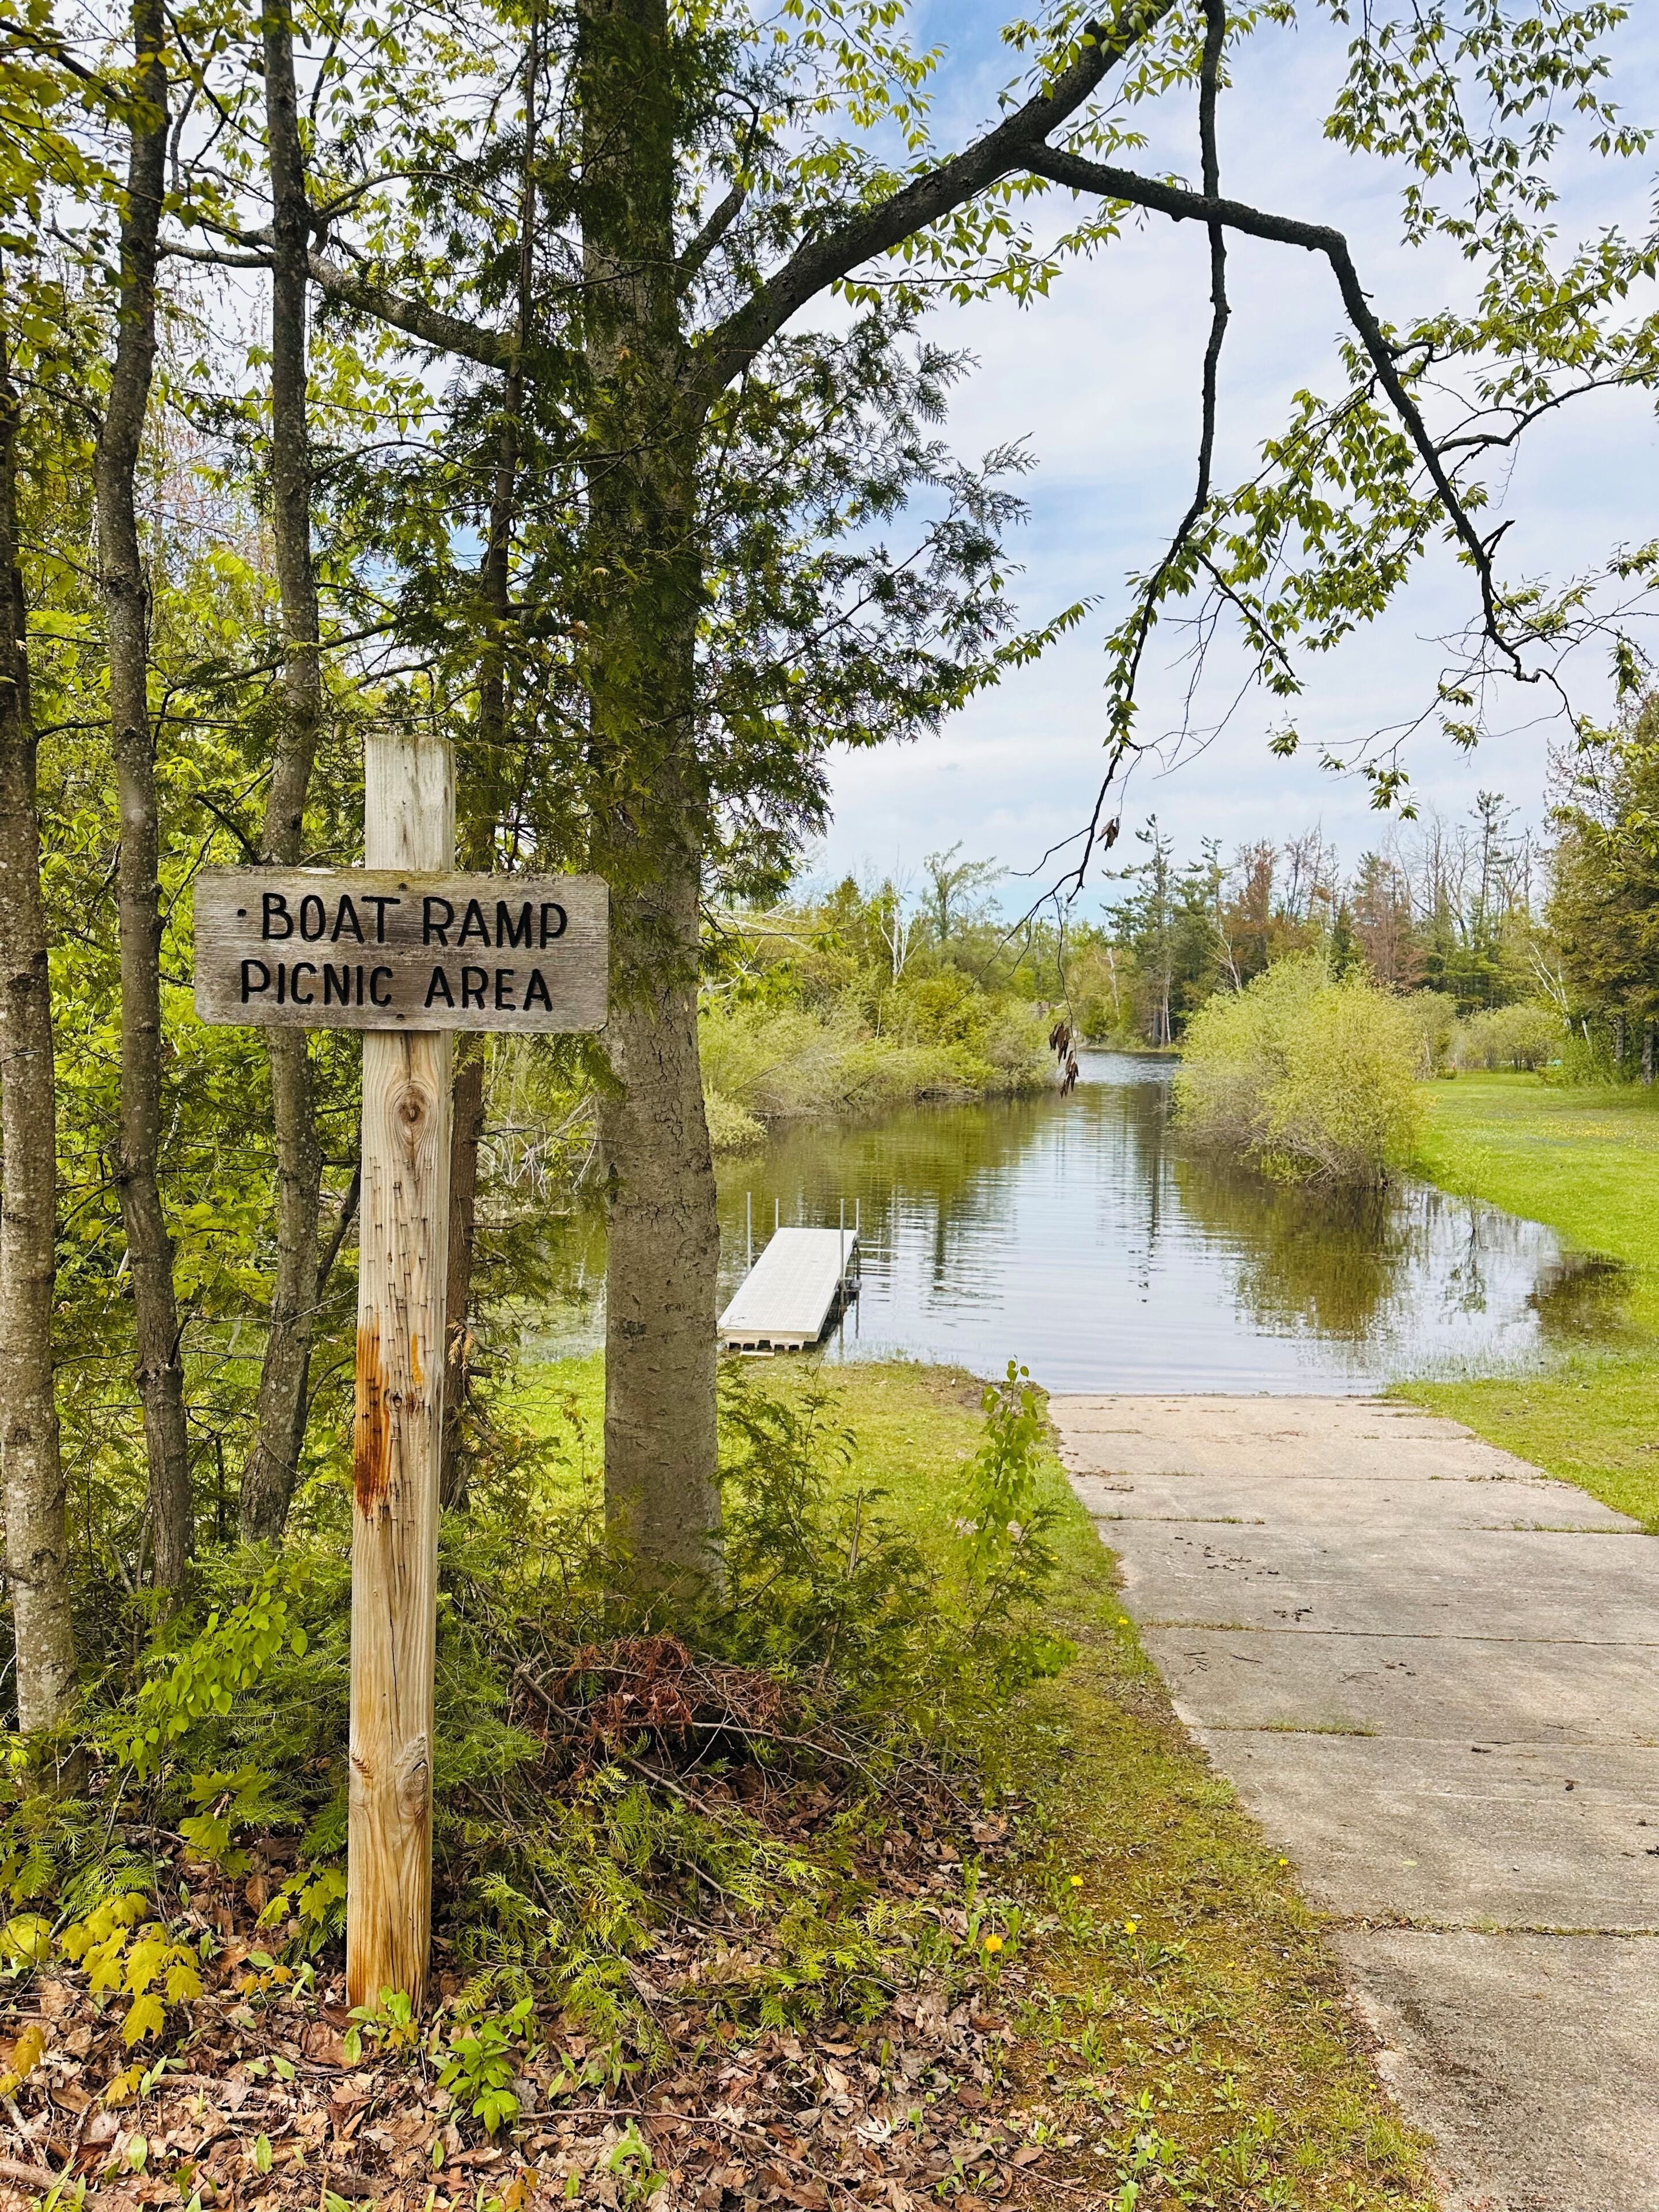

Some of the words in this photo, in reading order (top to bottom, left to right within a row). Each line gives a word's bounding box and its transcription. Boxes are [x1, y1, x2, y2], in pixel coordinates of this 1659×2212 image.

[262, 892, 401, 944] BOAT
[422, 896, 567, 950] RAMP
[240, 959, 393, 1007] PICNIC
[424, 965, 553, 1012] AREA
